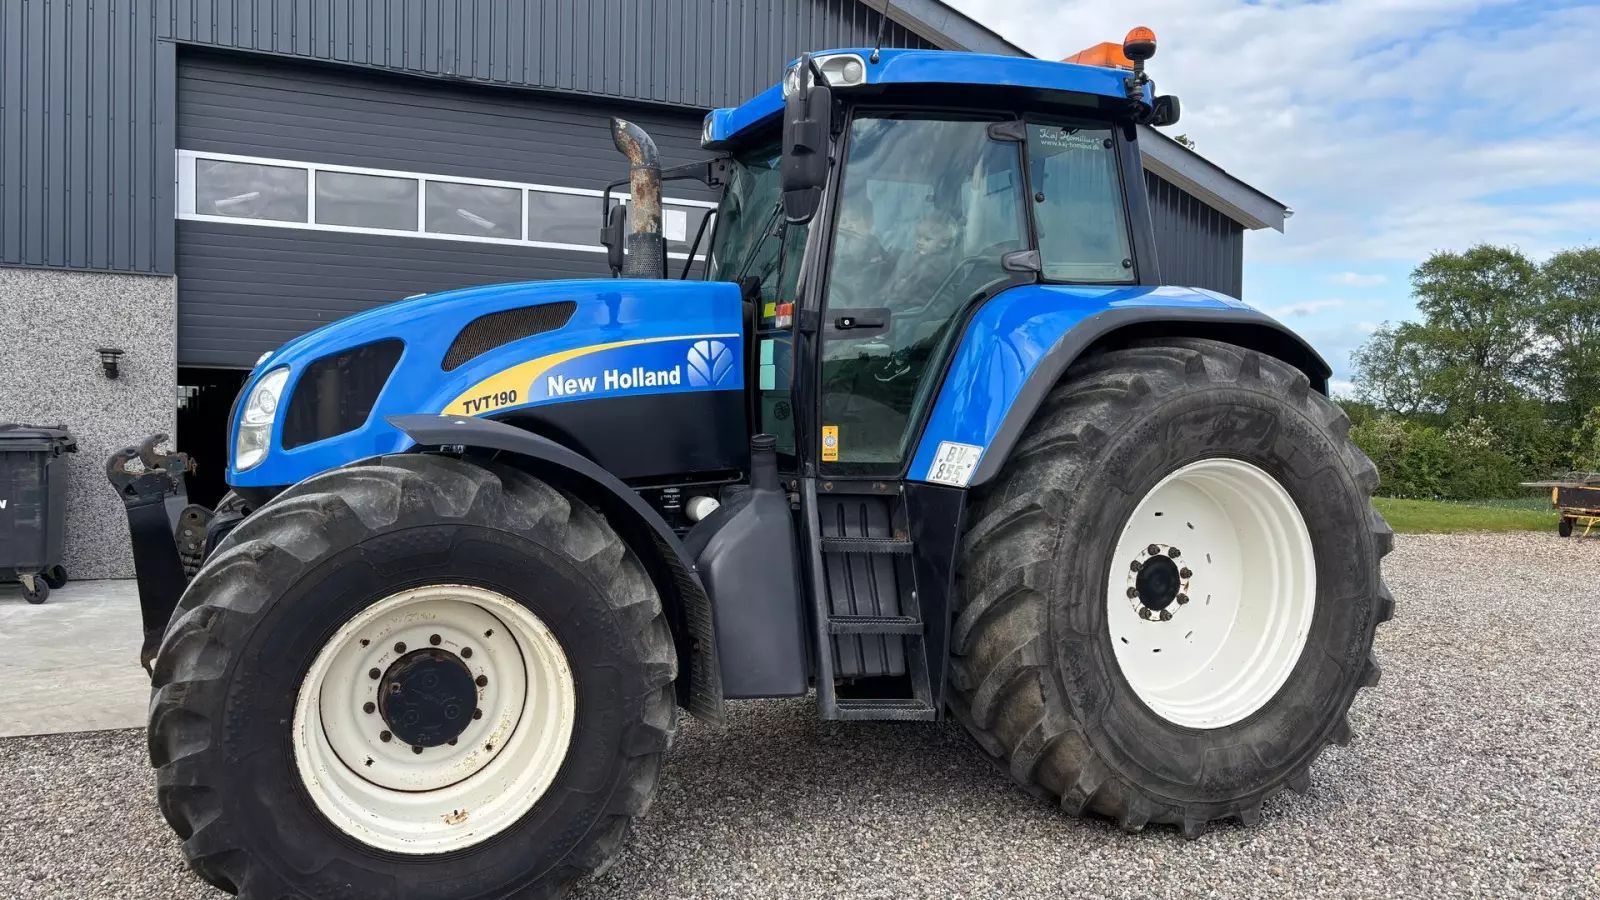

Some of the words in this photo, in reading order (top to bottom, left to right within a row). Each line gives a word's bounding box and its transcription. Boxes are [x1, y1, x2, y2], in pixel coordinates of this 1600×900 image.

[547, 375, 597, 396] New
[604, 365, 680, 391] Holland
[462, 389, 518, 415] TVT190
[935, 462, 964, 481] 855
